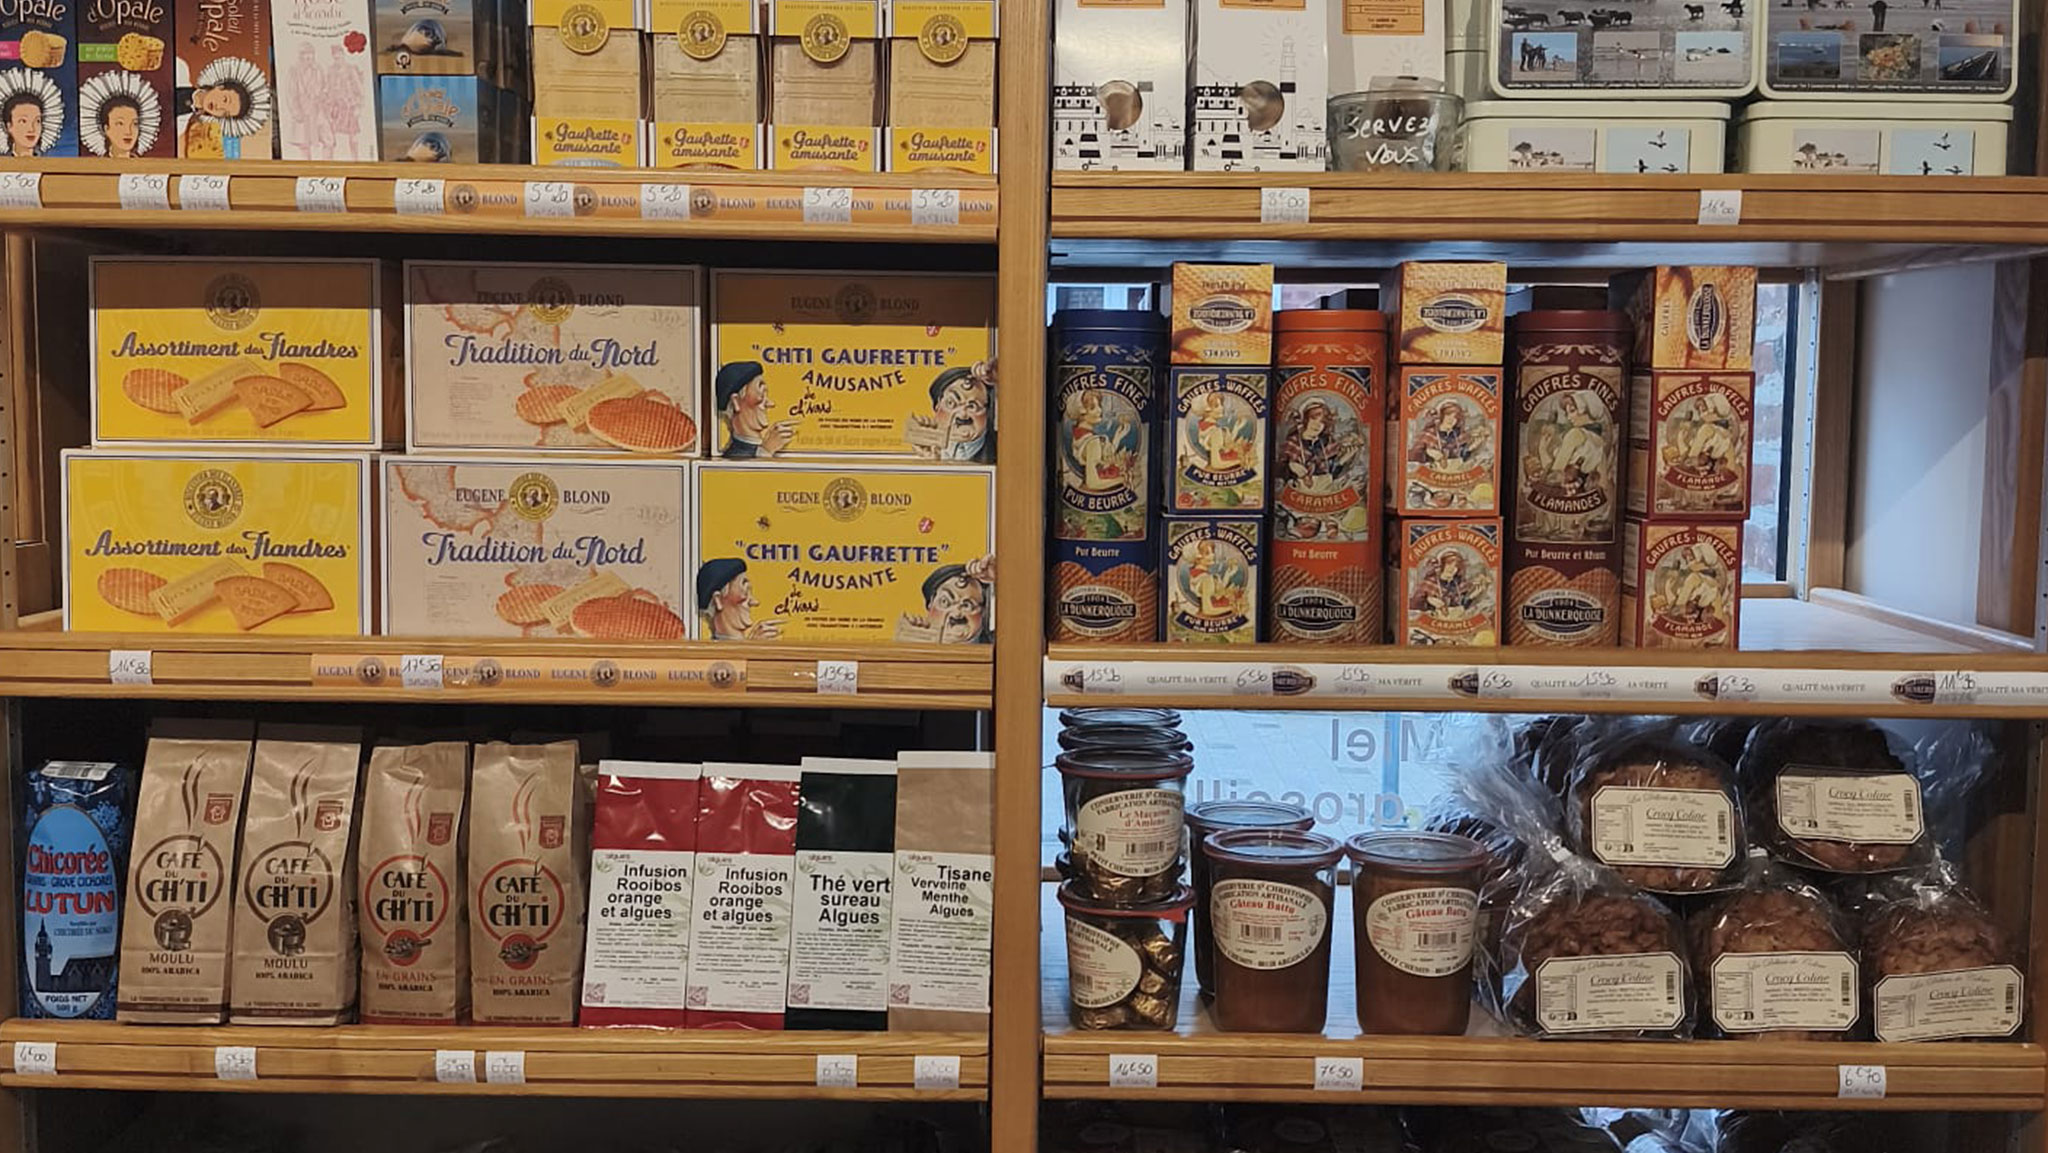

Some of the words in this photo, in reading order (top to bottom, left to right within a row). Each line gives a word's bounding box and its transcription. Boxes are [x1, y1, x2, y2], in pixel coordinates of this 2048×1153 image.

[556, 122, 619, 145] Gaufrette
[674, 128, 738, 148] Gaufrette
[793, 130, 857, 151] Gaufrette
[553, 140, 622, 154] amusante
[911, 131, 974, 153] Gaufrette
[671, 145, 740, 158] amusante
[790, 147, 858, 161] amusante
[908, 149, 976, 162] amusante
[482, 196, 518, 205] BLOND
[601, 198, 637, 206] BLOND
[720, 200, 755, 208] BLOND
[578, 293, 625, 307] BLOND
[111, 331, 240, 358] Assortiment
[259, 331, 360, 361] Flandres
[444, 334, 564, 367] Tradition
[569, 343, 591, 362] du
[590, 338, 660, 370] Nord
[802, 369, 907, 392] AMUSANTE
[1058, 373, 1108, 411] GAUFRES
[1114, 376, 1147, 411] FINES
[1177, 379, 1220, 412] GAUFRES
[1226, 380, 1266, 413] WAFFLES
[1277, 373, 1327, 412] GAUFRES
[1334, 376, 1369, 410] FINES
[1458, 382, 1497, 414] WAFFLES
[1523, 374, 1582, 413] GAUFRES
[1587, 379, 1618, 411] FINES
[1658, 381, 1704, 416] GAUFRES
[1709, 383, 1749, 416] WAFFLES
[1428, 470, 1471, 481] CARAMEL
[455, 488, 506, 503] EUGENE
[563, 490, 610, 504] BLOND
[777, 491, 820, 504] EUGENE
[870, 493, 912, 506] BLOND
[1066, 489, 1085, 507] PUR
[1088, 490, 1132, 509] BEURRE
[1289, 491, 1350, 507] CARAMEL
[1534, 493, 1601, 512] FLAMANDES
[85, 529, 222, 557] Assortiment
[242, 531, 347, 561] Flandres
[422, 532, 547, 566] Tradition
[552, 541, 576, 559] du
[575, 535, 648, 567] Nord
[1075, 546, 1089, 556] Pur
[1091, 546, 1120, 557] Beurre
[1168, 528, 1211, 560] GAUFRES
[1216, 529, 1258, 561] WAFFLES
[1458, 530, 1498, 562] WAFFLES
[1646, 532, 1690, 565] GAUFRES
[1696, 533, 1736, 565] WAFFLES
[1293, 548, 1306, 559] Pur
[1308, 549, 1339, 560] Beurre
[1525, 548, 1539, 559] Pur
[1541, 549, 1570, 560] Beurre
[1573, 551, 1582, 560] et
[788, 567, 897, 590] AMUSANTE
[1070, 603, 1134, 617] DUNKERQUOISE
[1288, 606, 1354, 620] DUNKERQUOISE
[1523, 607, 1534, 618] LA
[1535, 607, 1602, 622] DUNKERQUOISE
[1429, 619, 1474, 630] CARAMEL
[1665, 622, 1712, 632] FLAMANDE
[318, 666, 354, 676] EUGENE
[505, 668, 541, 678] BLOND
[623, 670, 657, 679] BLOND
[668, 671, 704, 680] EUGENE
[28, 842, 109, 875] Chicorée
[164, 870, 179, 879] DU
[624, 864, 687, 878] Infusion
[726, 867, 788, 881] Infusion
[937, 865, 992, 882] Tisane
[274, 876, 289, 885] DU
[617, 878, 682, 892] Rooibos
[810, 873, 846, 891] Thé
[852, 876, 891, 893] vert
[911, 876, 966, 890] Verveine
[392, 889, 405, 897] DU
[718, 881, 783, 896] Rooibos
[26, 890, 115, 914] LUTUN
[505, 894, 520, 903] DU
[607, 893, 662, 907] orange
[709, 896, 763, 911] orange
[820, 893, 880, 907] sureau
[922, 890, 969, 904] Menthe
[1381, 891, 1437, 908] CONSERVERIE
[601, 906, 616, 918] et
[620, 905, 672, 921] algues
[929, 904, 974, 919] Algues
[1230, 898, 1263, 910] Gâteau
[1267, 902, 1295, 915] Battu
[1388, 898, 1440, 914] FABRICATION
[703, 909, 718, 921] et
[722, 909, 773, 925] algues
[818, 908, 880, 927] Algues
[1406, 907, 1443, 920] Gâteau
[149, 953, 194, 965] MOULU
[263, 958, 308, 969] MOULU
[163, 967, 200, 975] ARABICA
[278, 972, 314, 980] ARABICA
[392, 971, 436, 982] GRAINS
[489, 975, 505, 985] EN
[509, 975, 554, 986] GRAINS
[398, 984, 433, 992] ARABICA
[514, 988, 550, 997] ARABICA
[71, 994, 88, 1003] NET
